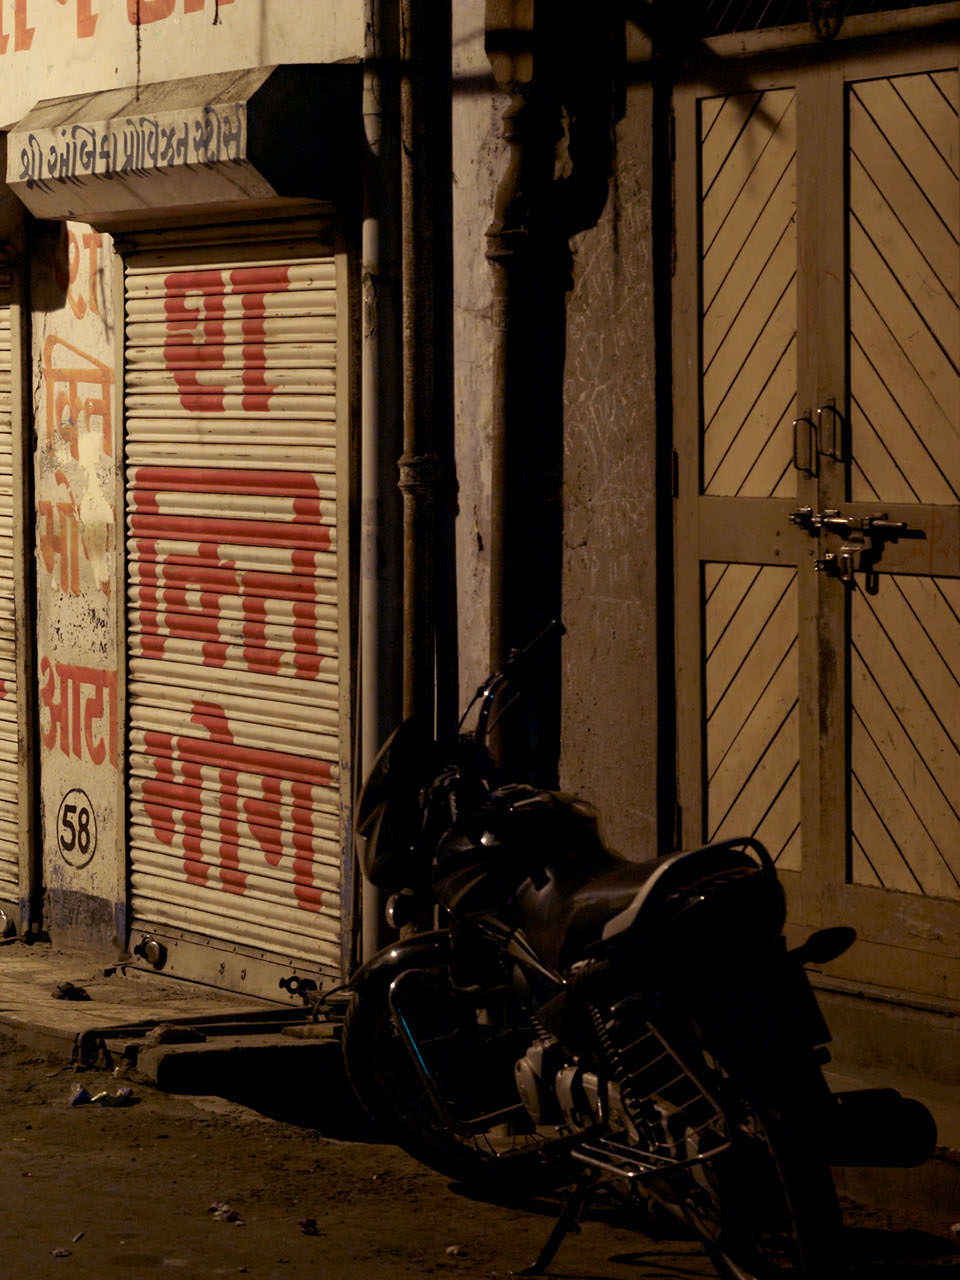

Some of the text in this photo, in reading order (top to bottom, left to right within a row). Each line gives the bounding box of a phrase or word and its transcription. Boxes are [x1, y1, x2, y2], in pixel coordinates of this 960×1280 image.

[20, 133, 50, 190] શ્રી
[47, 124, 119, 182] અંબિકા
[40, 656, 120, 770] आटा
[59, 803, 93, 857] 58
[139, 700, 340, 913] भोग
